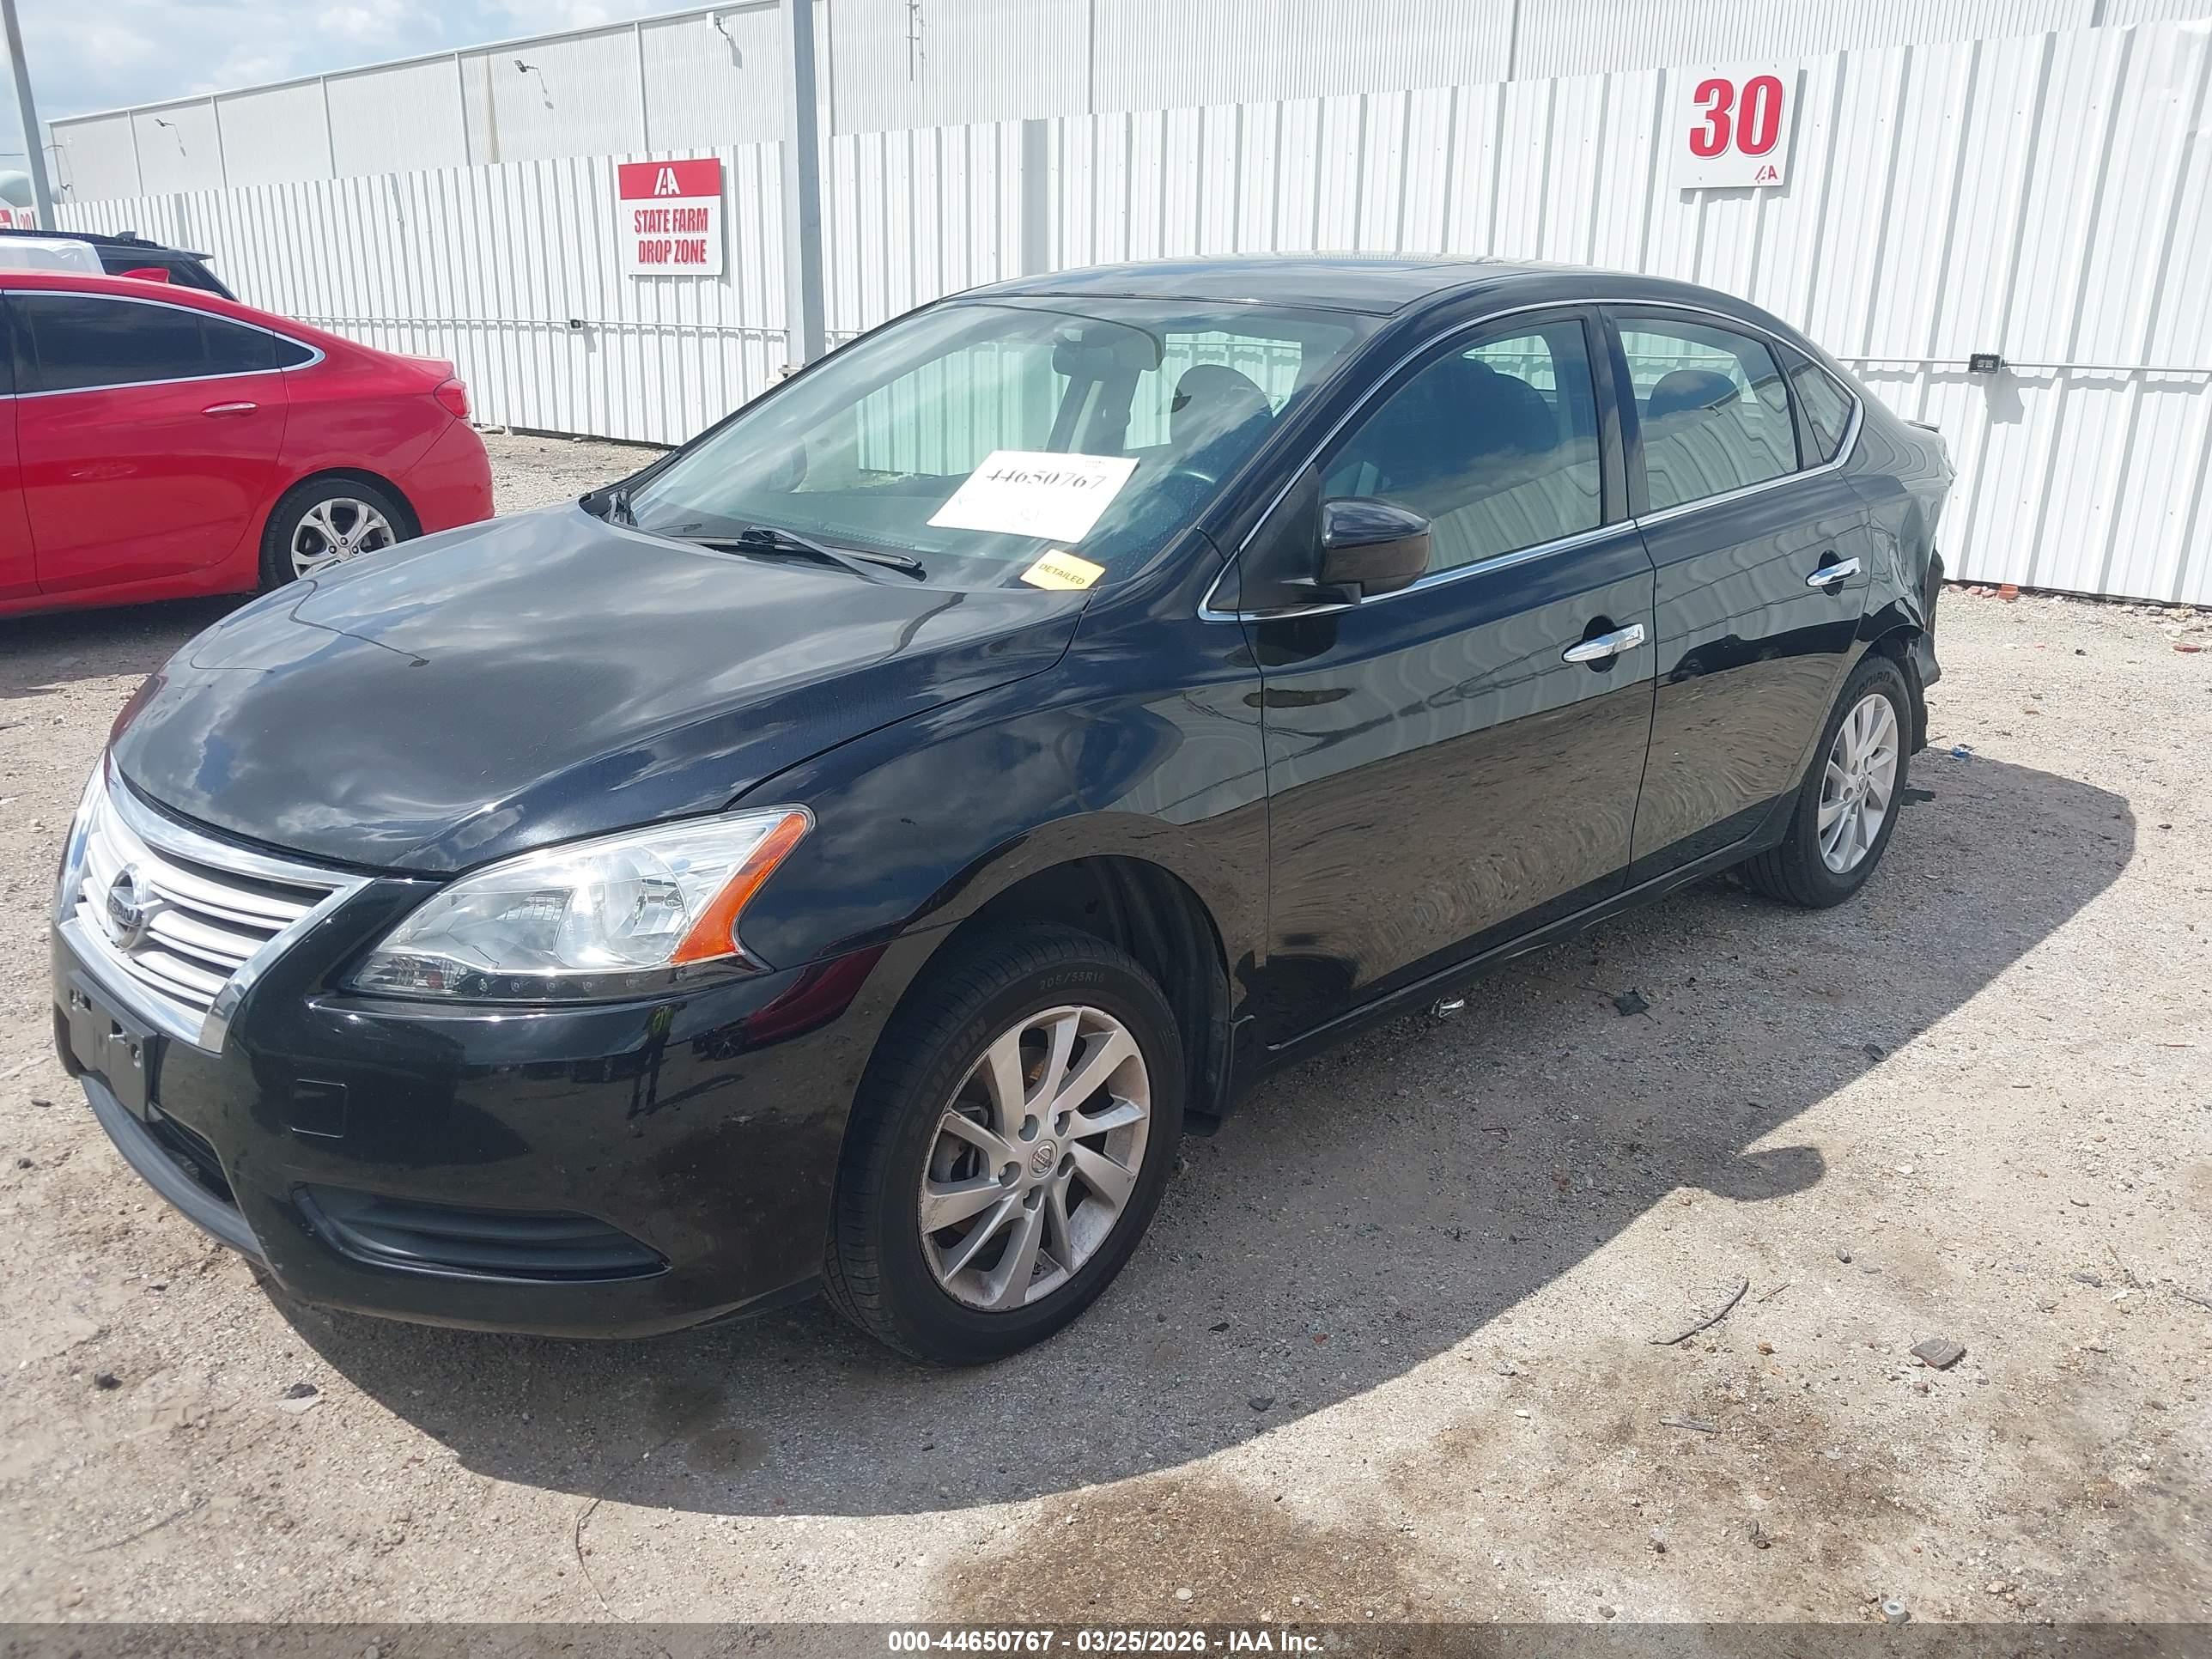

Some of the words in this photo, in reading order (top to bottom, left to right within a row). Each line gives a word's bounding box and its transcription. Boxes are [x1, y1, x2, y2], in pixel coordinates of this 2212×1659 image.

[1689, 76, 1785, 160] 30
[634, 209, 670, 234] STATE
[672, 207, 708, 234] FARM
[638, 240, 672, 264] DROP
[673, 239, 707, 264] ZONE
[986, 468, 1108, 489] 44650767
[1038, 563, 1085, 586] DETAILED
